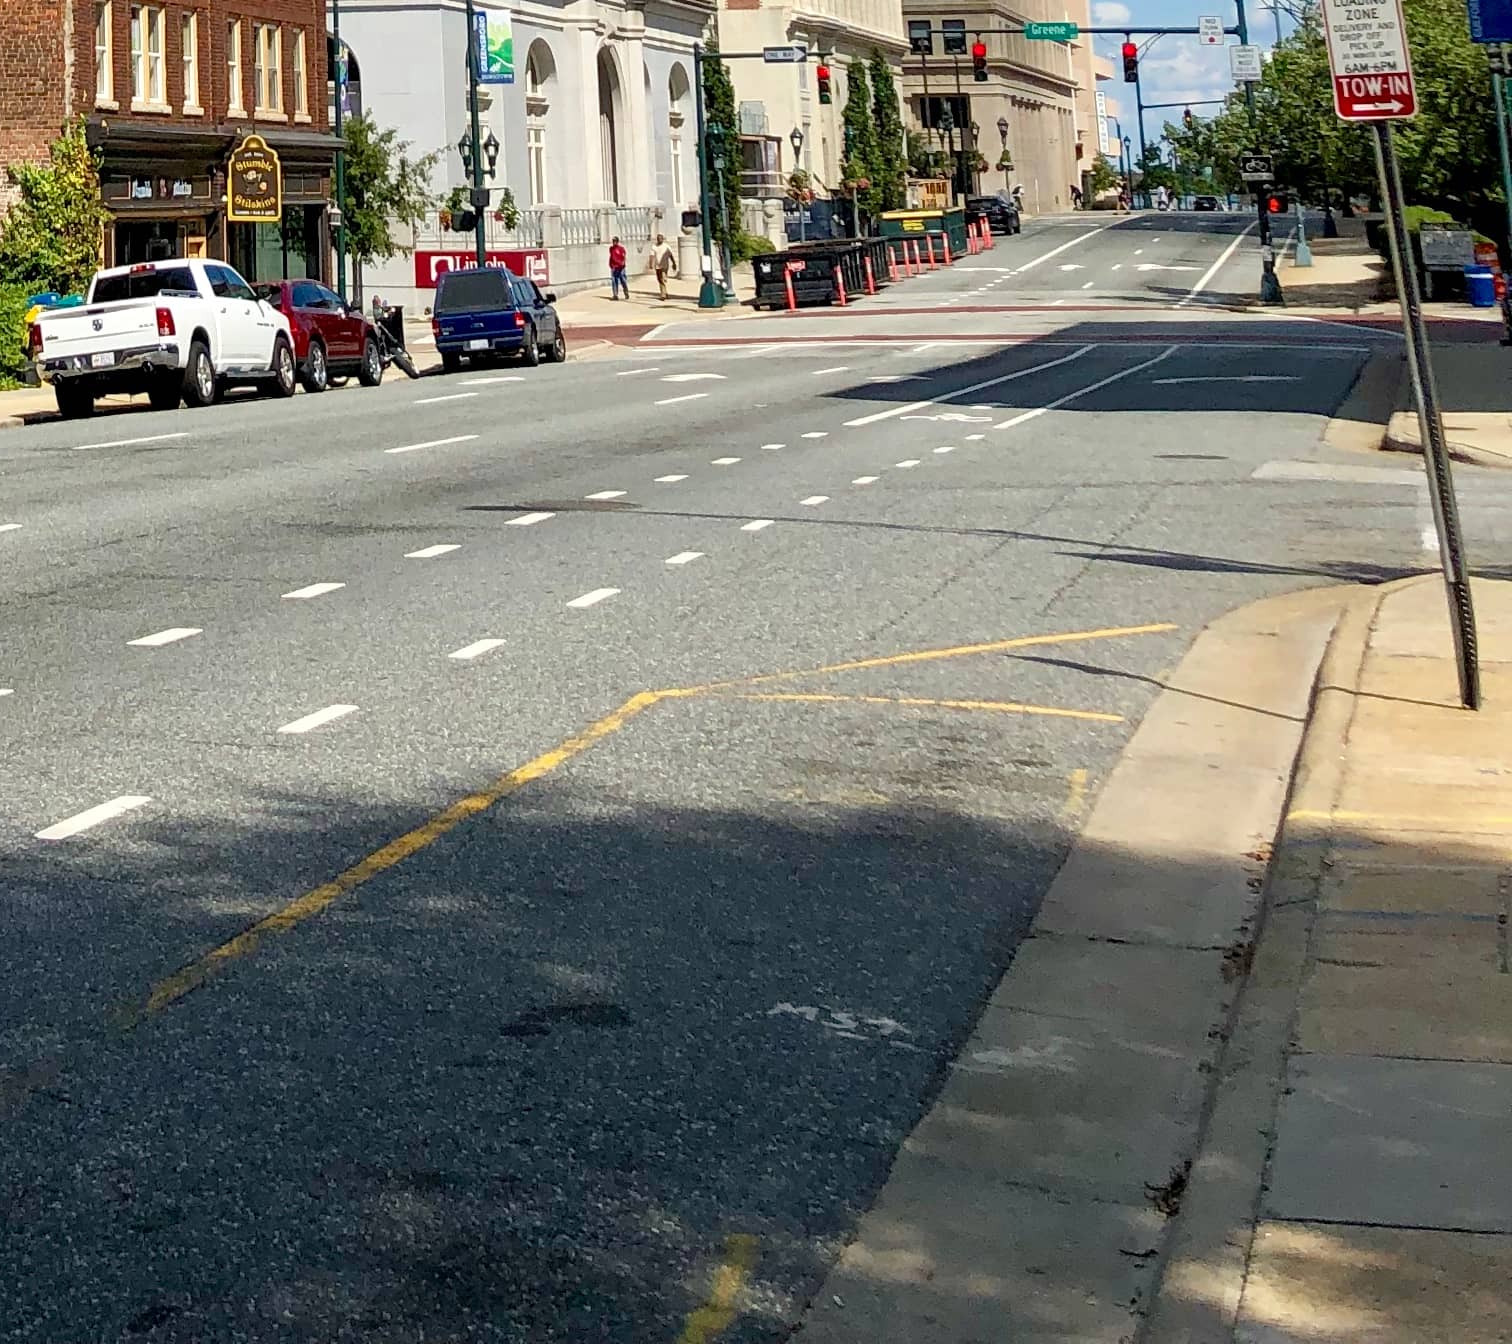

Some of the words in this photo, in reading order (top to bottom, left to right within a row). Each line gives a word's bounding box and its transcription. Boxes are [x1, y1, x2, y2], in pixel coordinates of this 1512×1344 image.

[1345, 8, 1380, 21] ZONE
[1031, 23, 1067, 35] Greene
[1333, 23, 1373, 33] DELIVERY
[1377, 21, 1395, 30] AND
[1339, 32, 1363, 42] DROP
[1366, 31, 1381, 40] OFF
[477, 15, 489, 73] GREENSBORO
[1349, 42, 1368, 50] PICK
[1372, 40, 1385, 49] UP
[1339, 75, 1410, 98] TOW-IN
[235, 158, 274, 172] Stumble
[455, 255, 507, 271] Linoln
